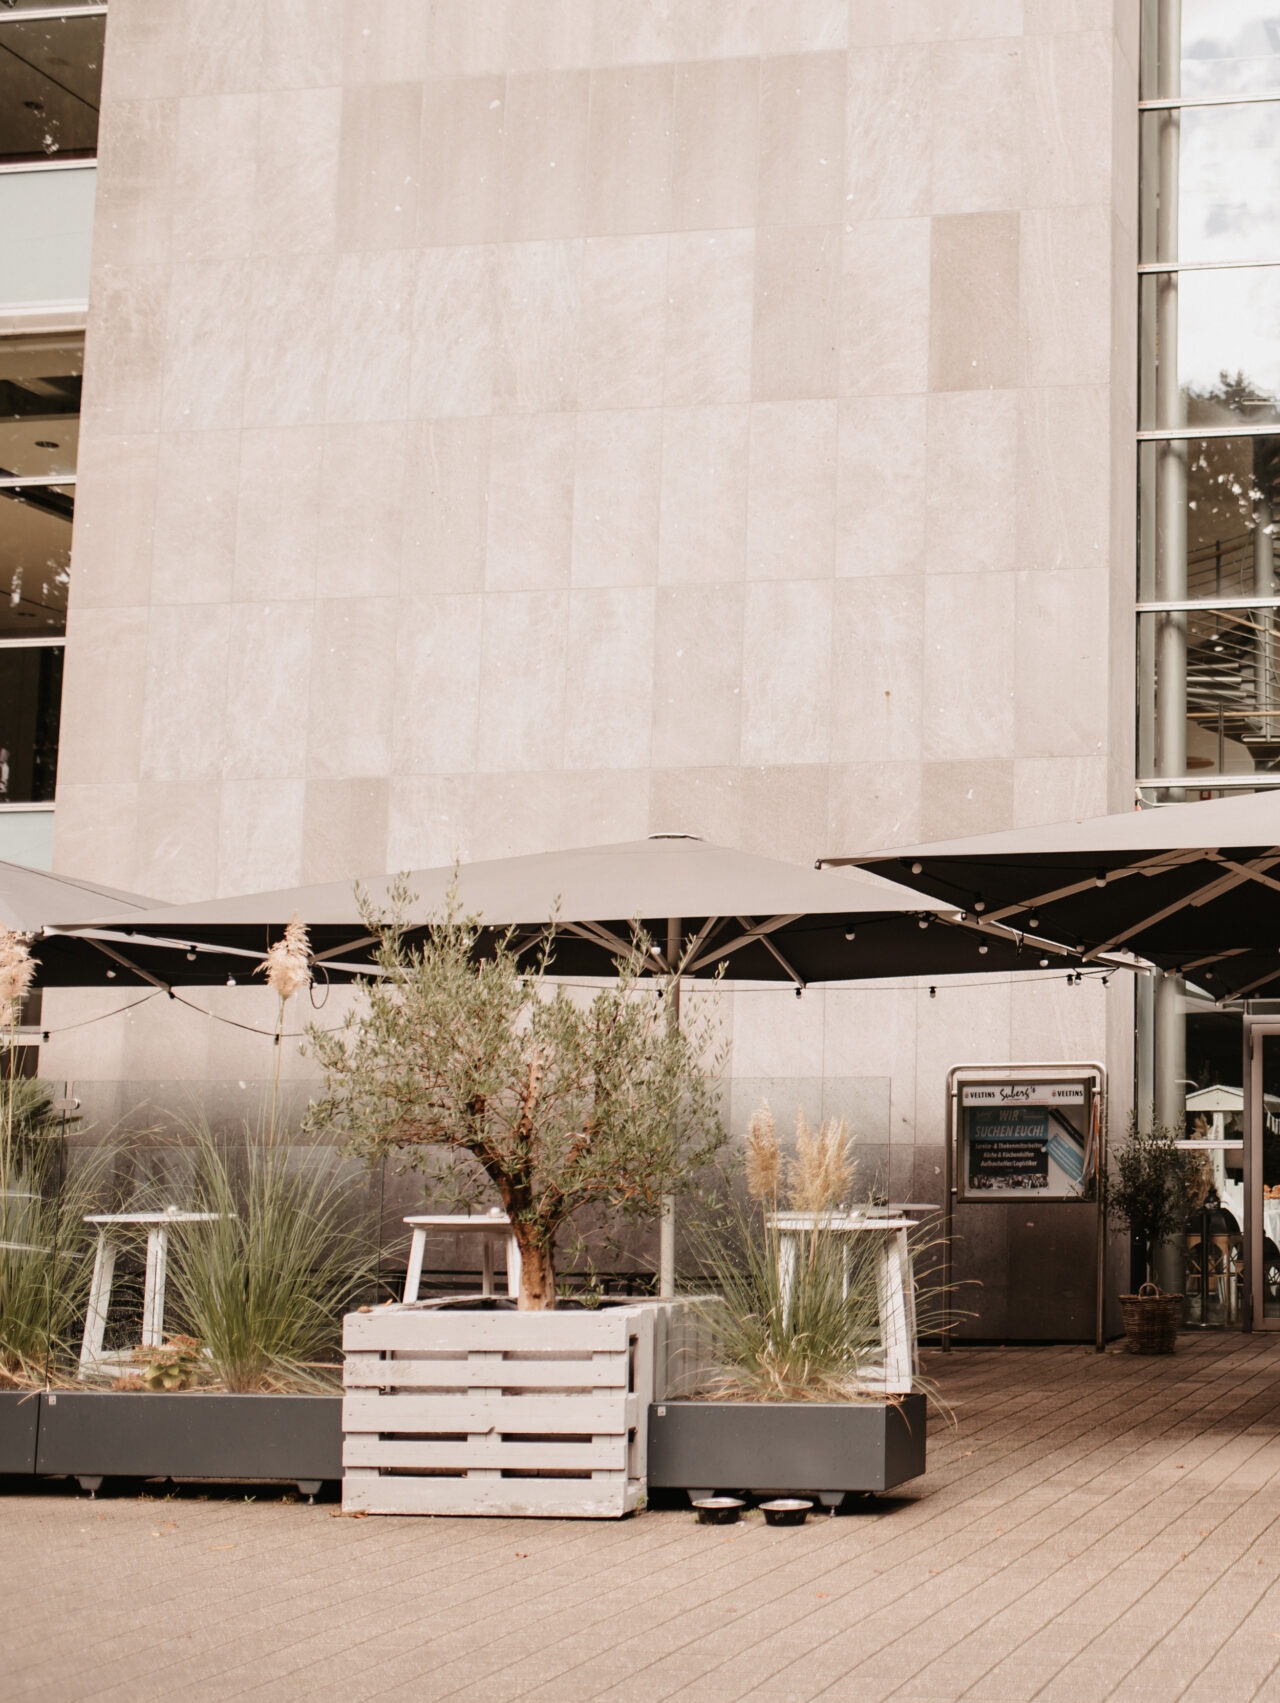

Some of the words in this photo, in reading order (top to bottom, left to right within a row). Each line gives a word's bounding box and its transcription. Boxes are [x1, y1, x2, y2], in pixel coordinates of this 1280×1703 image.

[970, 1091, 996, 1099] VELTINS
[1000, 1109, 1019, 1121] WIR
[975, 1125, 1013, 1137] SUCHEN
[1014, 1125, 1044, 1137] EUCH!
